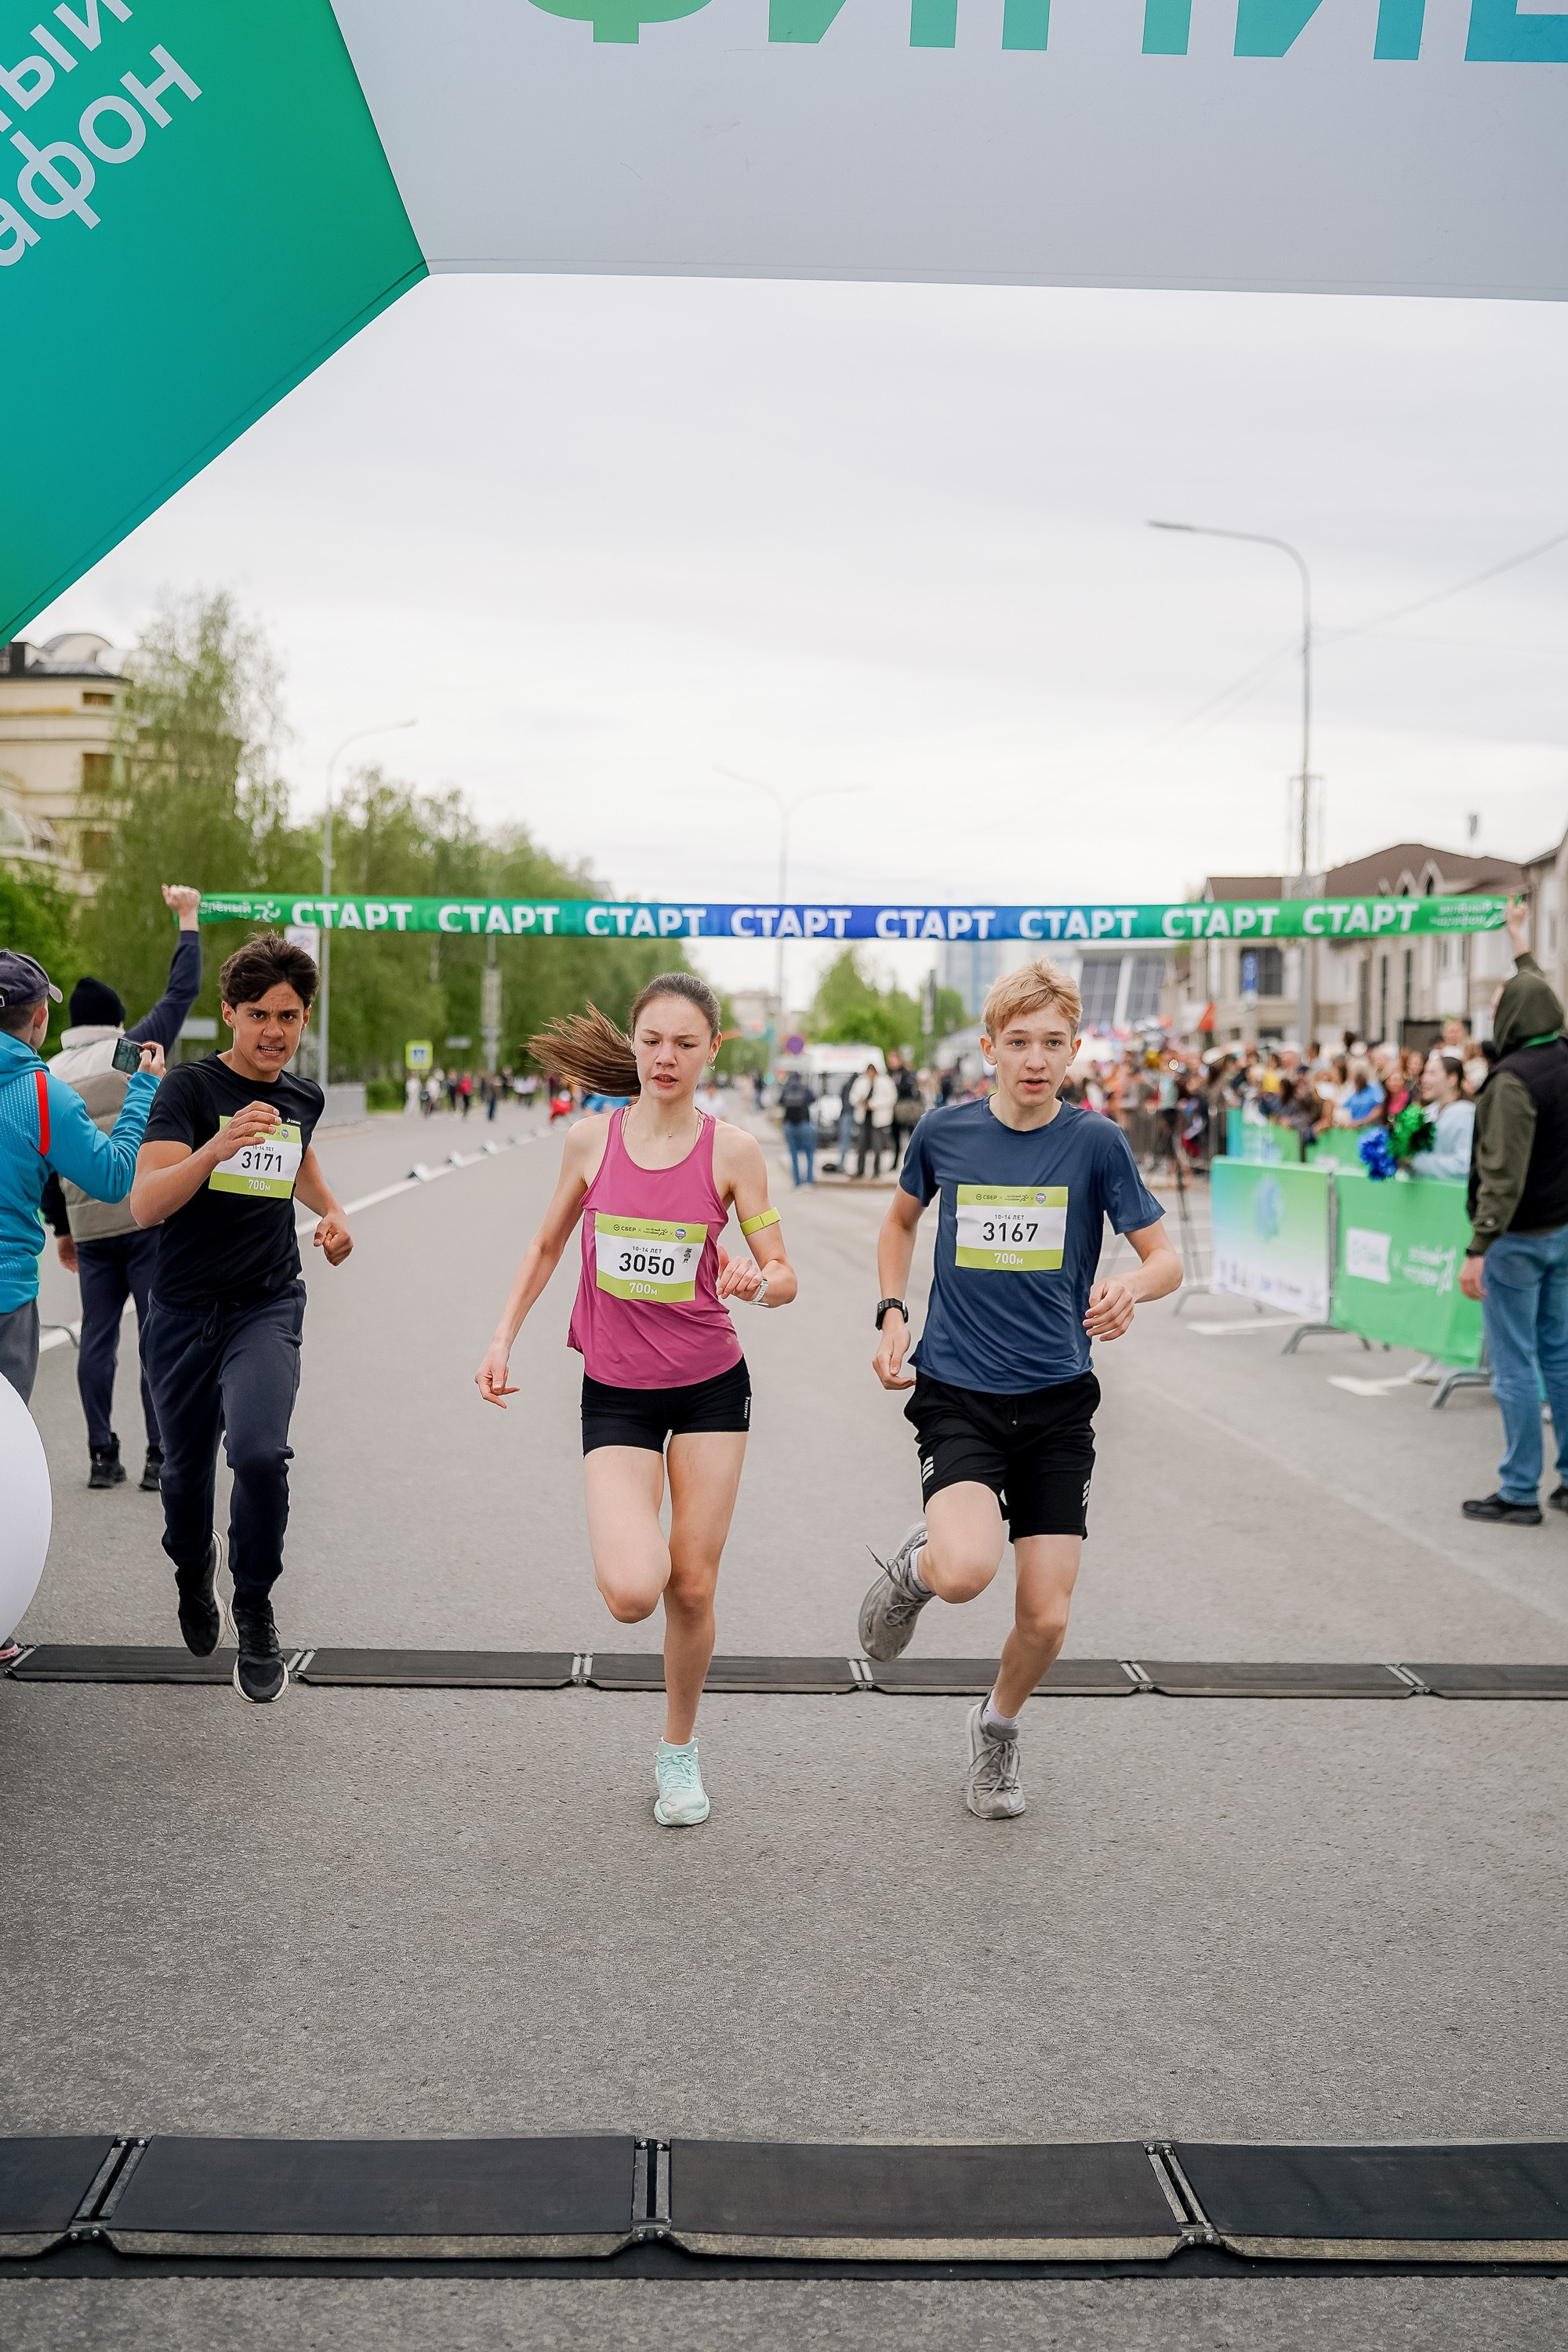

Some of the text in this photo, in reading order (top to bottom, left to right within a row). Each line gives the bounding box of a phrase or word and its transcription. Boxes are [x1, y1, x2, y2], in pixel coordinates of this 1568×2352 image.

[292, 901, 413, 932] СТАРТ
[437, 904, 561, 935] СТАРТ
[584, 906, 707, 938] СТАРТ
[730, 908, 853, 939] СТАРТ
[874, 909, 996, 940] СТАРТ
[1018, 909, 1140, 940] СТАРТ
[1160, 905, 1280, 938] СТАРТ
[1301, 902, 1420, 935] СТАРТ
[241, 1151, 282, 1172] 3171
[982, 1221, 1039, 1243] 3167
[619, 1252, 675, 1276] 3050
